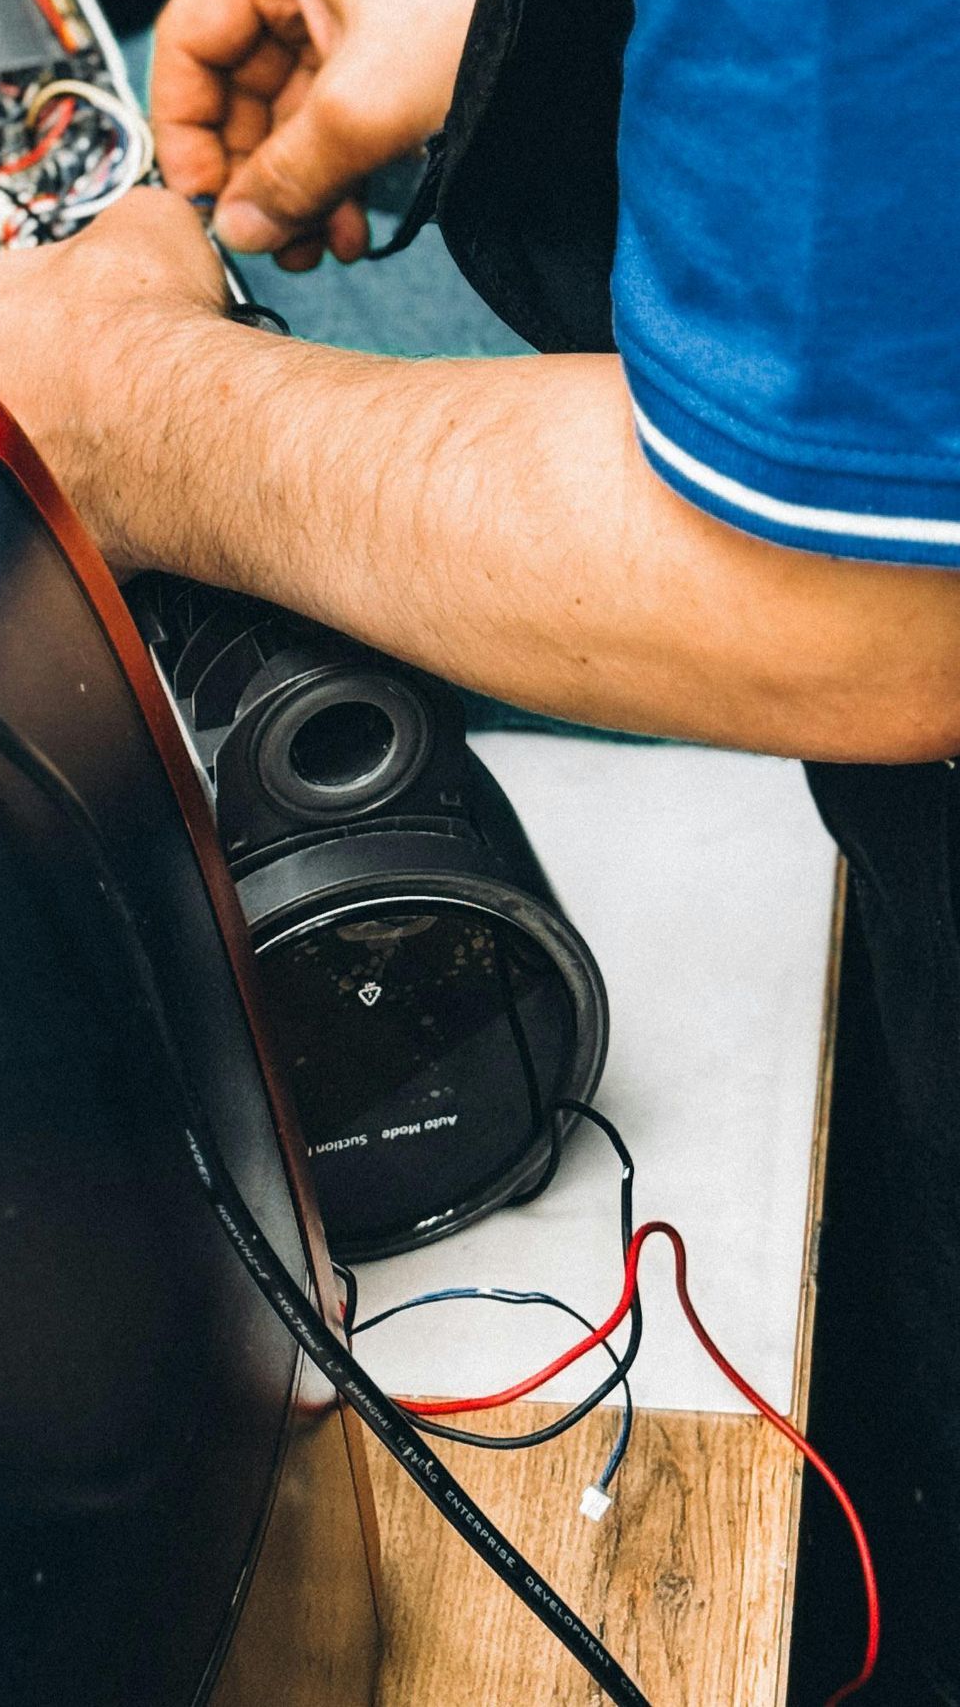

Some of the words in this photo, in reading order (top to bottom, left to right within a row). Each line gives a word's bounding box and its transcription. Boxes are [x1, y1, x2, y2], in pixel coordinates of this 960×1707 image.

[424, 1114, 458, 1130] Auto
[381, 1123, 421, 1140] Mode
[316, 1134, 368, 1153] Suction
[345, 1380, 393, 1431] SHANGHAI
[445, 1489, 517, 1569] ENTERPRISE
[525, 1575, 611, 1667] DEVELOPMENT
